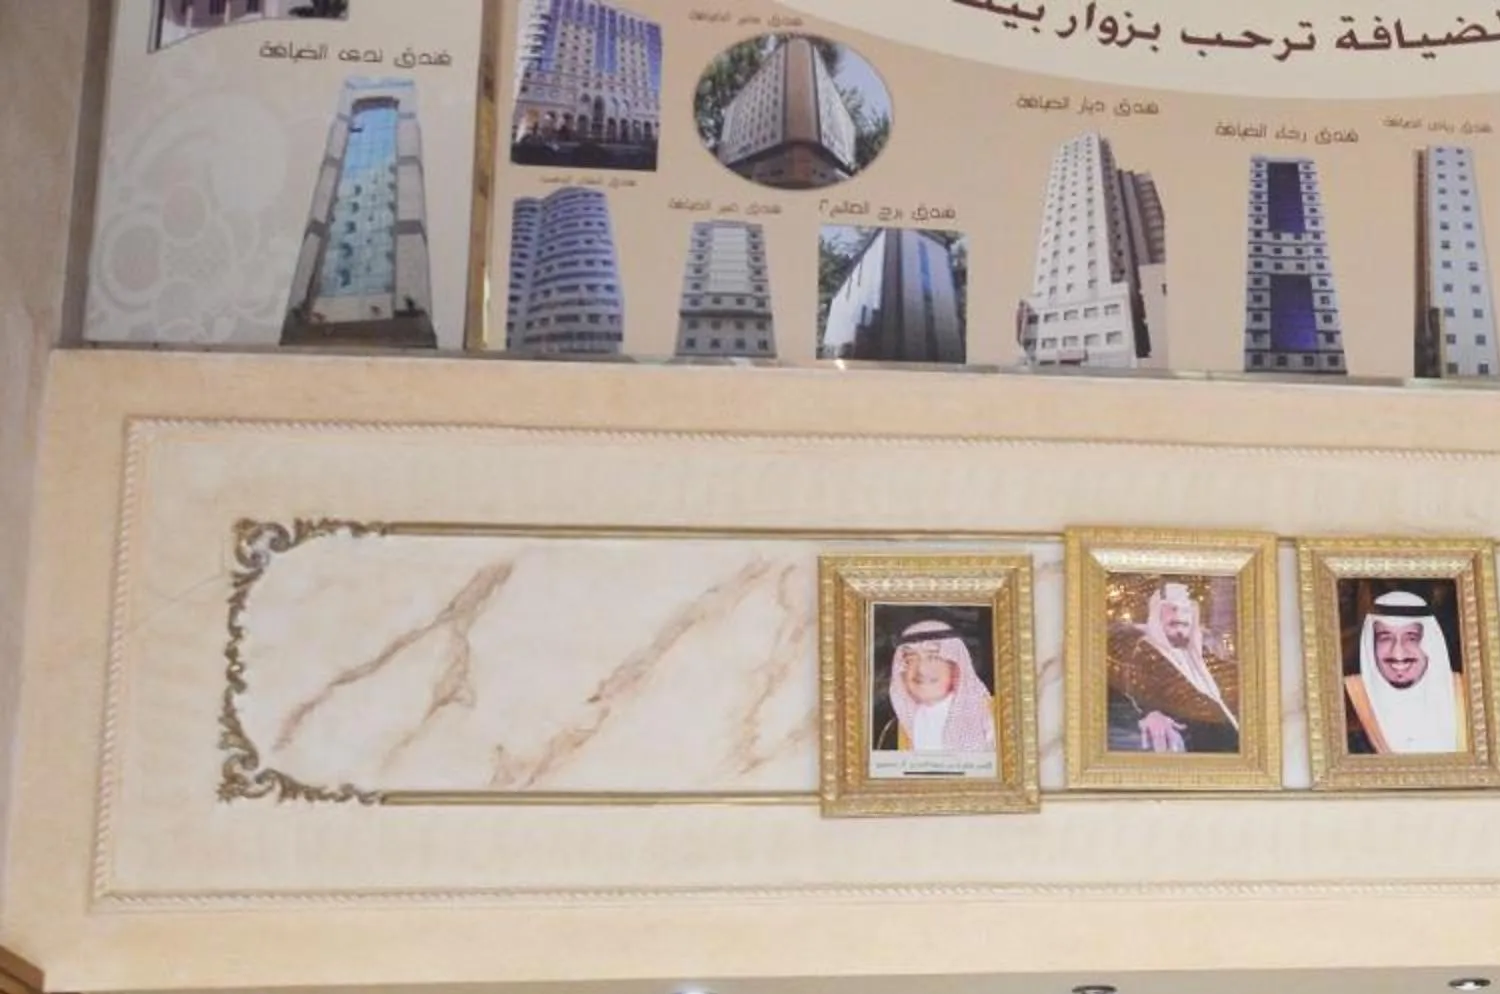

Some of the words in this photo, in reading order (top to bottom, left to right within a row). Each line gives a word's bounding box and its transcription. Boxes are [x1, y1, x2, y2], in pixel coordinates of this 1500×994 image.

[1055, 0, 1161, 53] بزوار
[259, 40, 328, 63] الضيافة
[1181, 21, 1316, 61] ترحب
[393, 46, 452, 69] فندق
[1113, 96, 1159, 117] فندق
[1215, 121, 1267, 140] الضيافة
[1315, 126, 1359, 145] فندق
[911, 202, 956, 221] فندق
